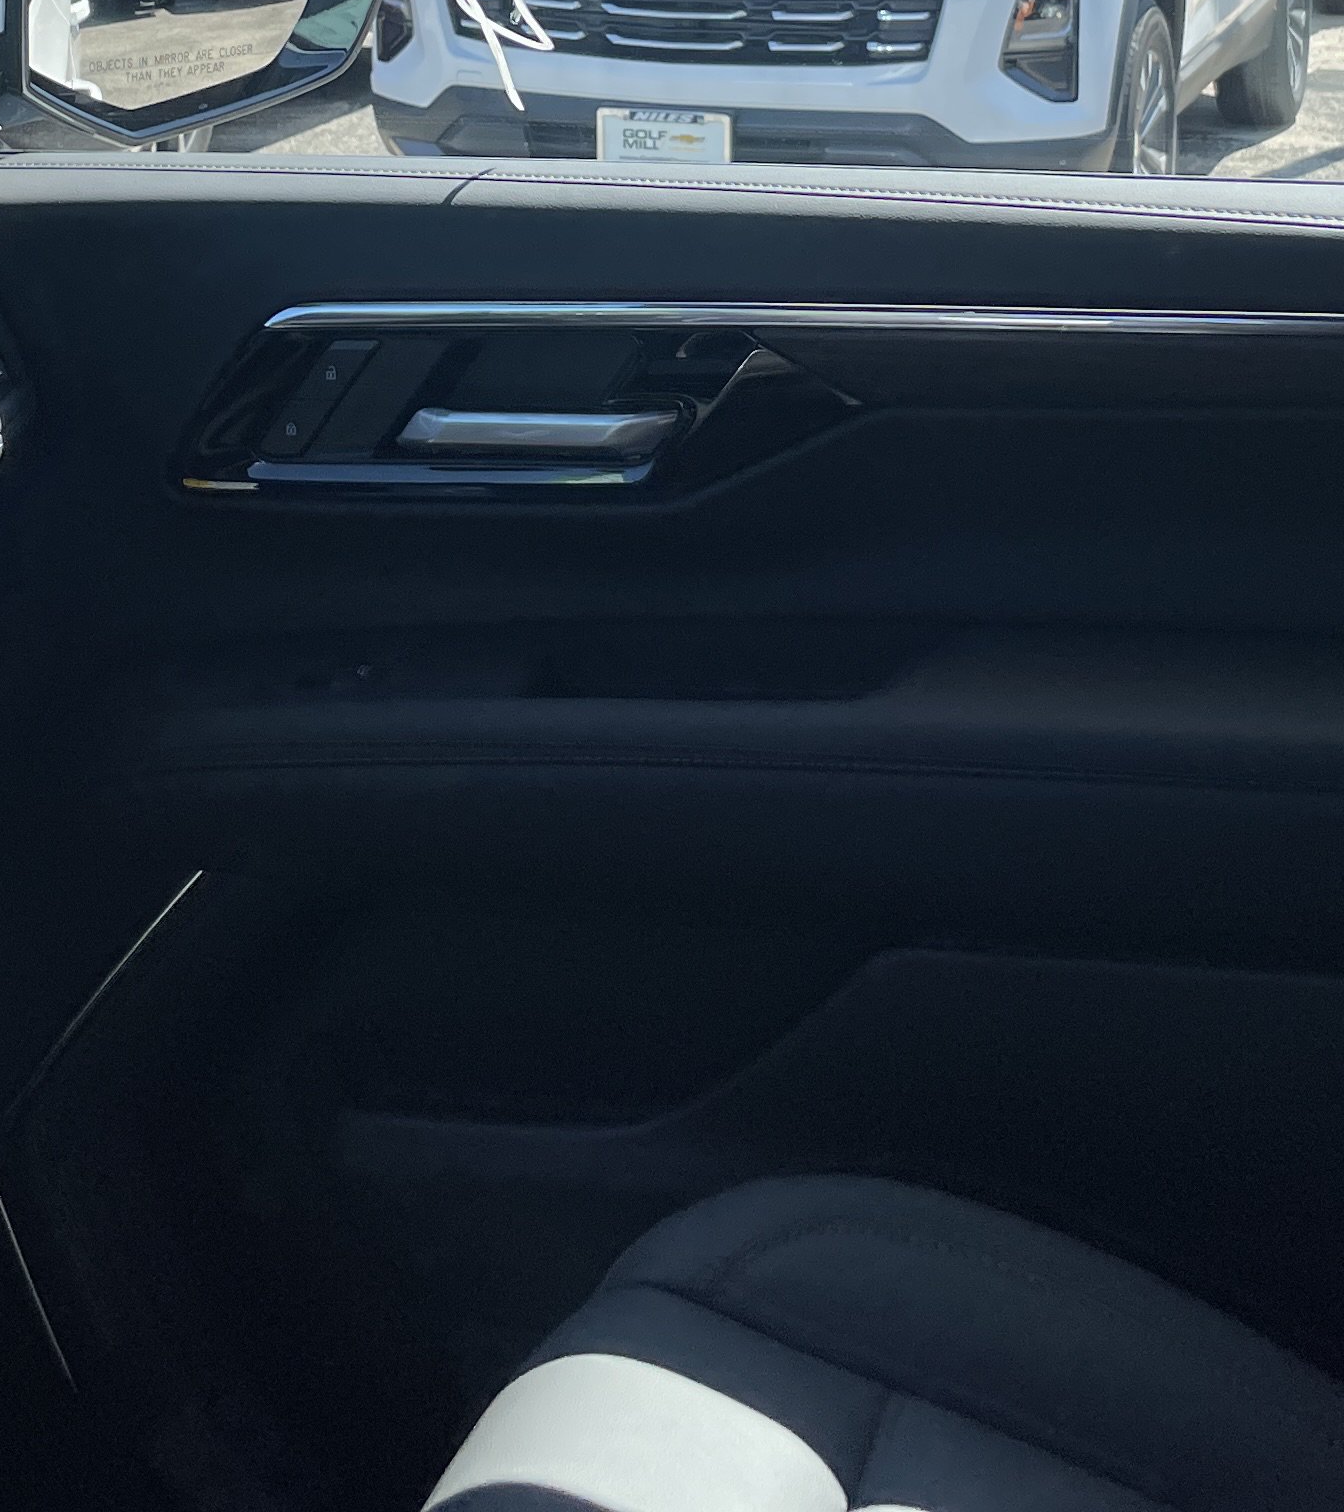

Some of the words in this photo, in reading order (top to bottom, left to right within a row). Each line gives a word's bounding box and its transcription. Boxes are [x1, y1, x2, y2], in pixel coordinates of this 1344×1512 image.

[88, 57, 133, 72] OBJECTS
[138, 58, 148, 68] IN
[155, 52, 190, 65] MIRROR
[196, 48, 214, 60] ARE
[219, 44, 253, 58] CLOSER
[126, 71, 152, 83] THAN
[158, 67, 182, 79] THEY
[186, 62, 224, 76] APPEAR
[634, 112, 695, 123] NILES
[622, 128, 668, 140] GOLF
[622, 139, 660, 150] MILL
